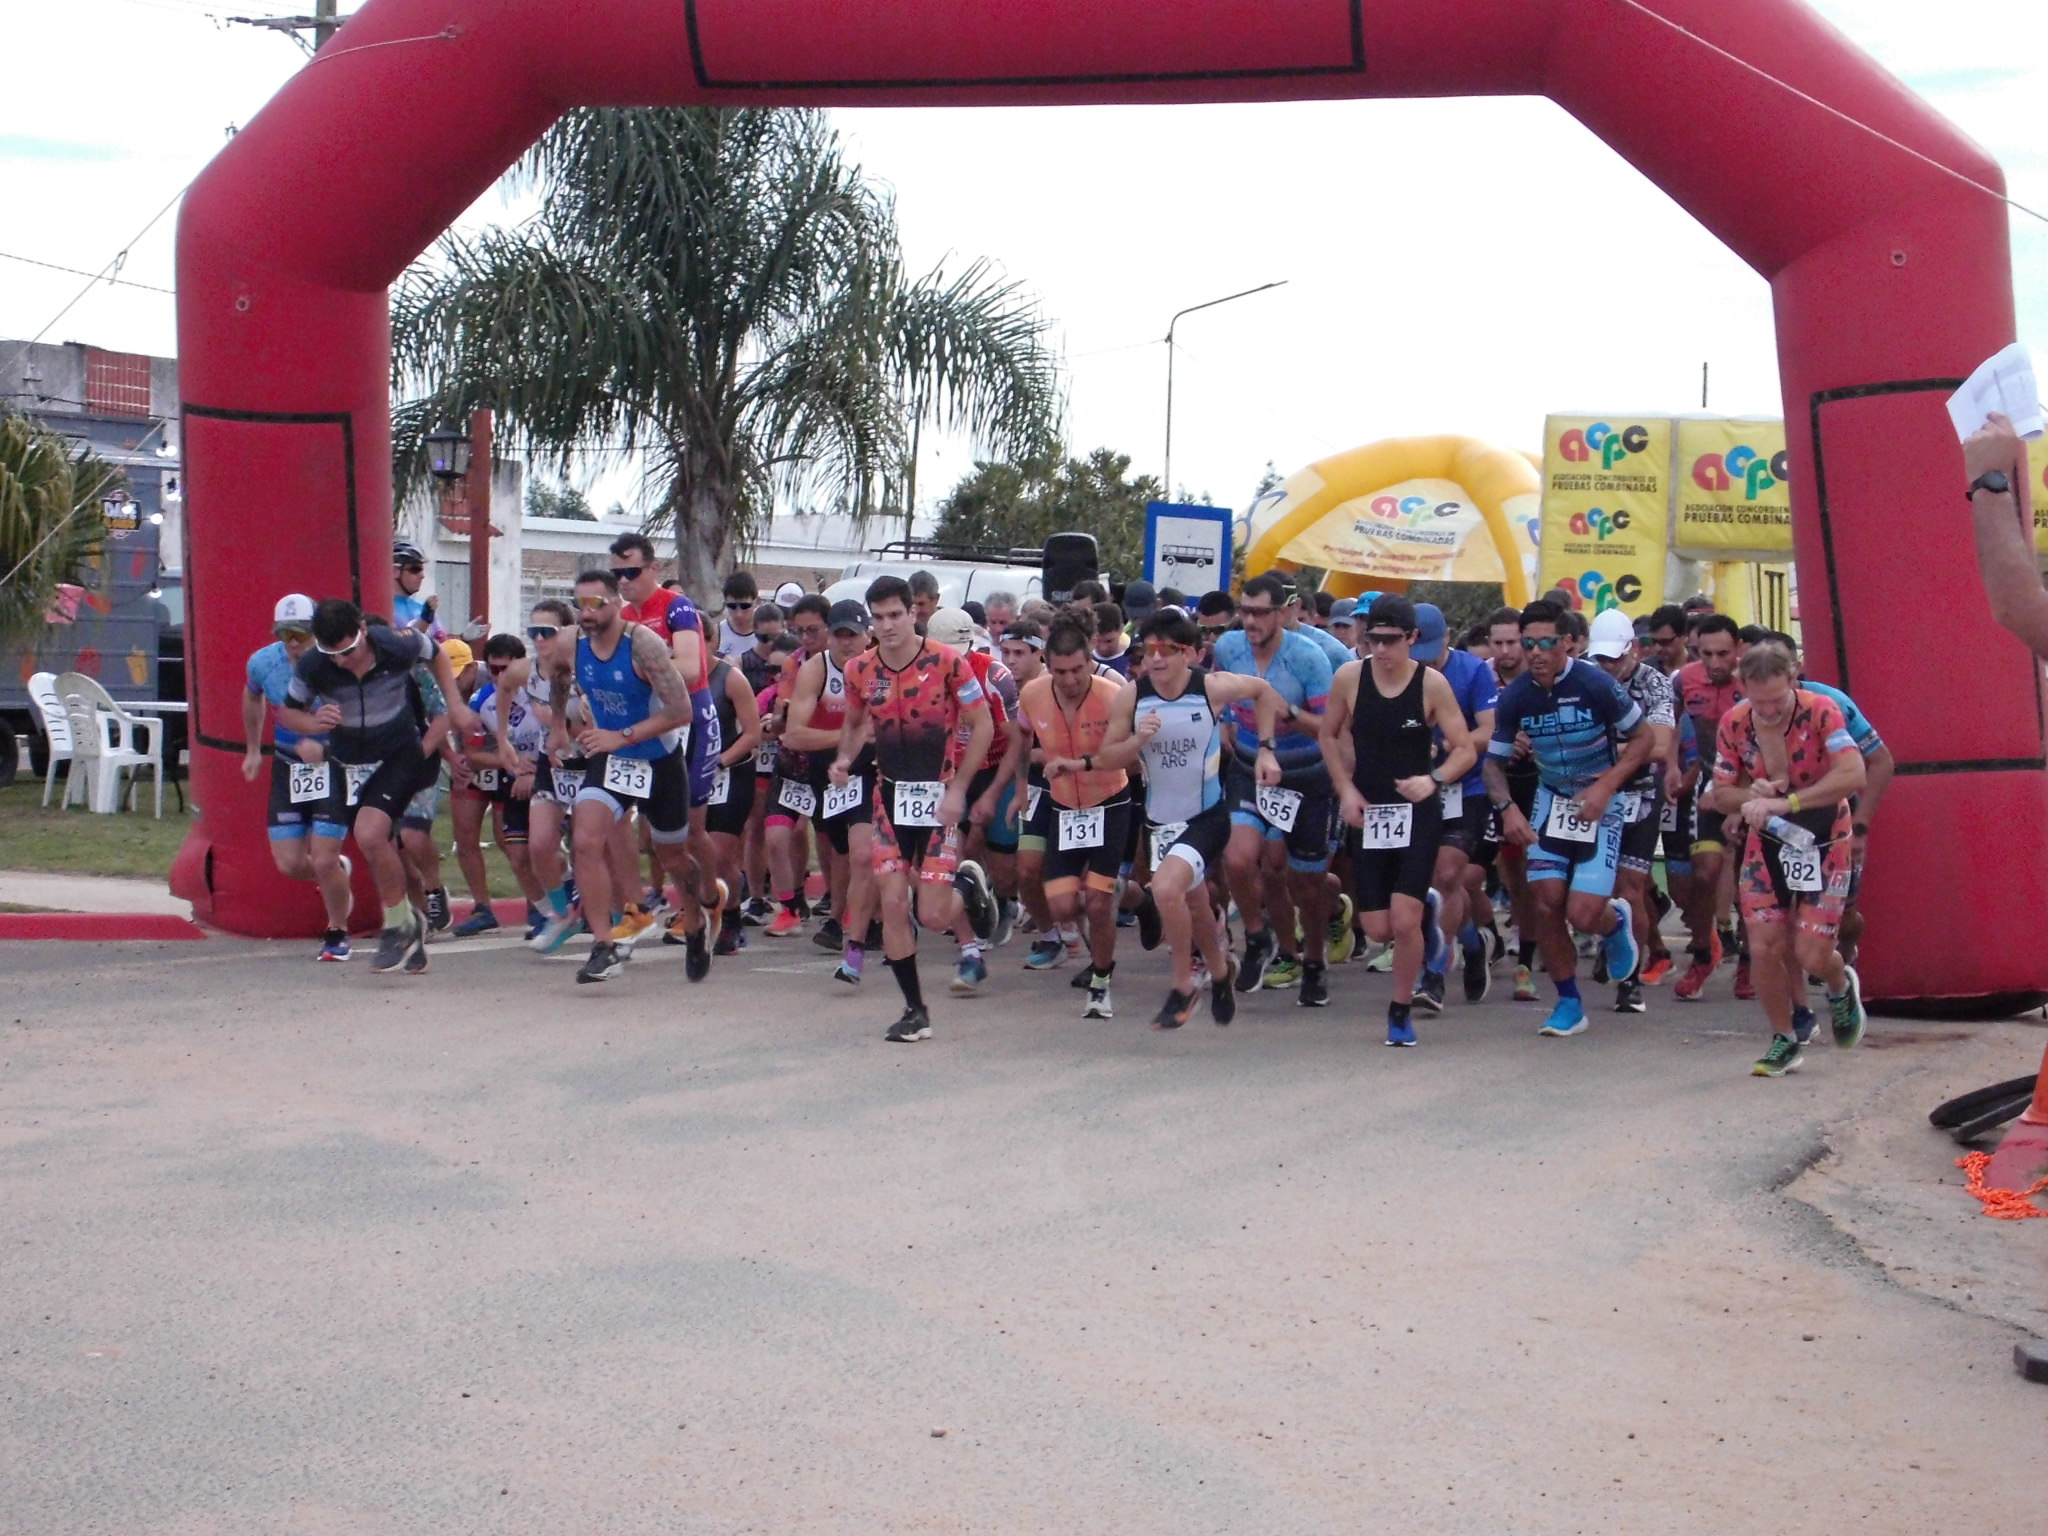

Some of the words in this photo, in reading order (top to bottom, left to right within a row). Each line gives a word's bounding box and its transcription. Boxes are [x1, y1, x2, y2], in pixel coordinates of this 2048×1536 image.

[1684, 513, 1734, 523] PRUEBAS
[1150, 738, 1197, 753] VILLALBA
[1161, 753, 1188, 769] ARG
[293, 776, 325, 794] 026
[610, 770, 646, 789] 213
[784, 790, 812, 811] 033
[828, 788, 858, 811] 019
[899, 800, 936, 819] 184
[1260, 798, 1293, 822] 055
[1065, 822, 1098, 841] 131
[1370, 821, 1405, 840] 114
[1556, 813, 1592, 833] 199
[1782, 860, 1816, 882] 082
